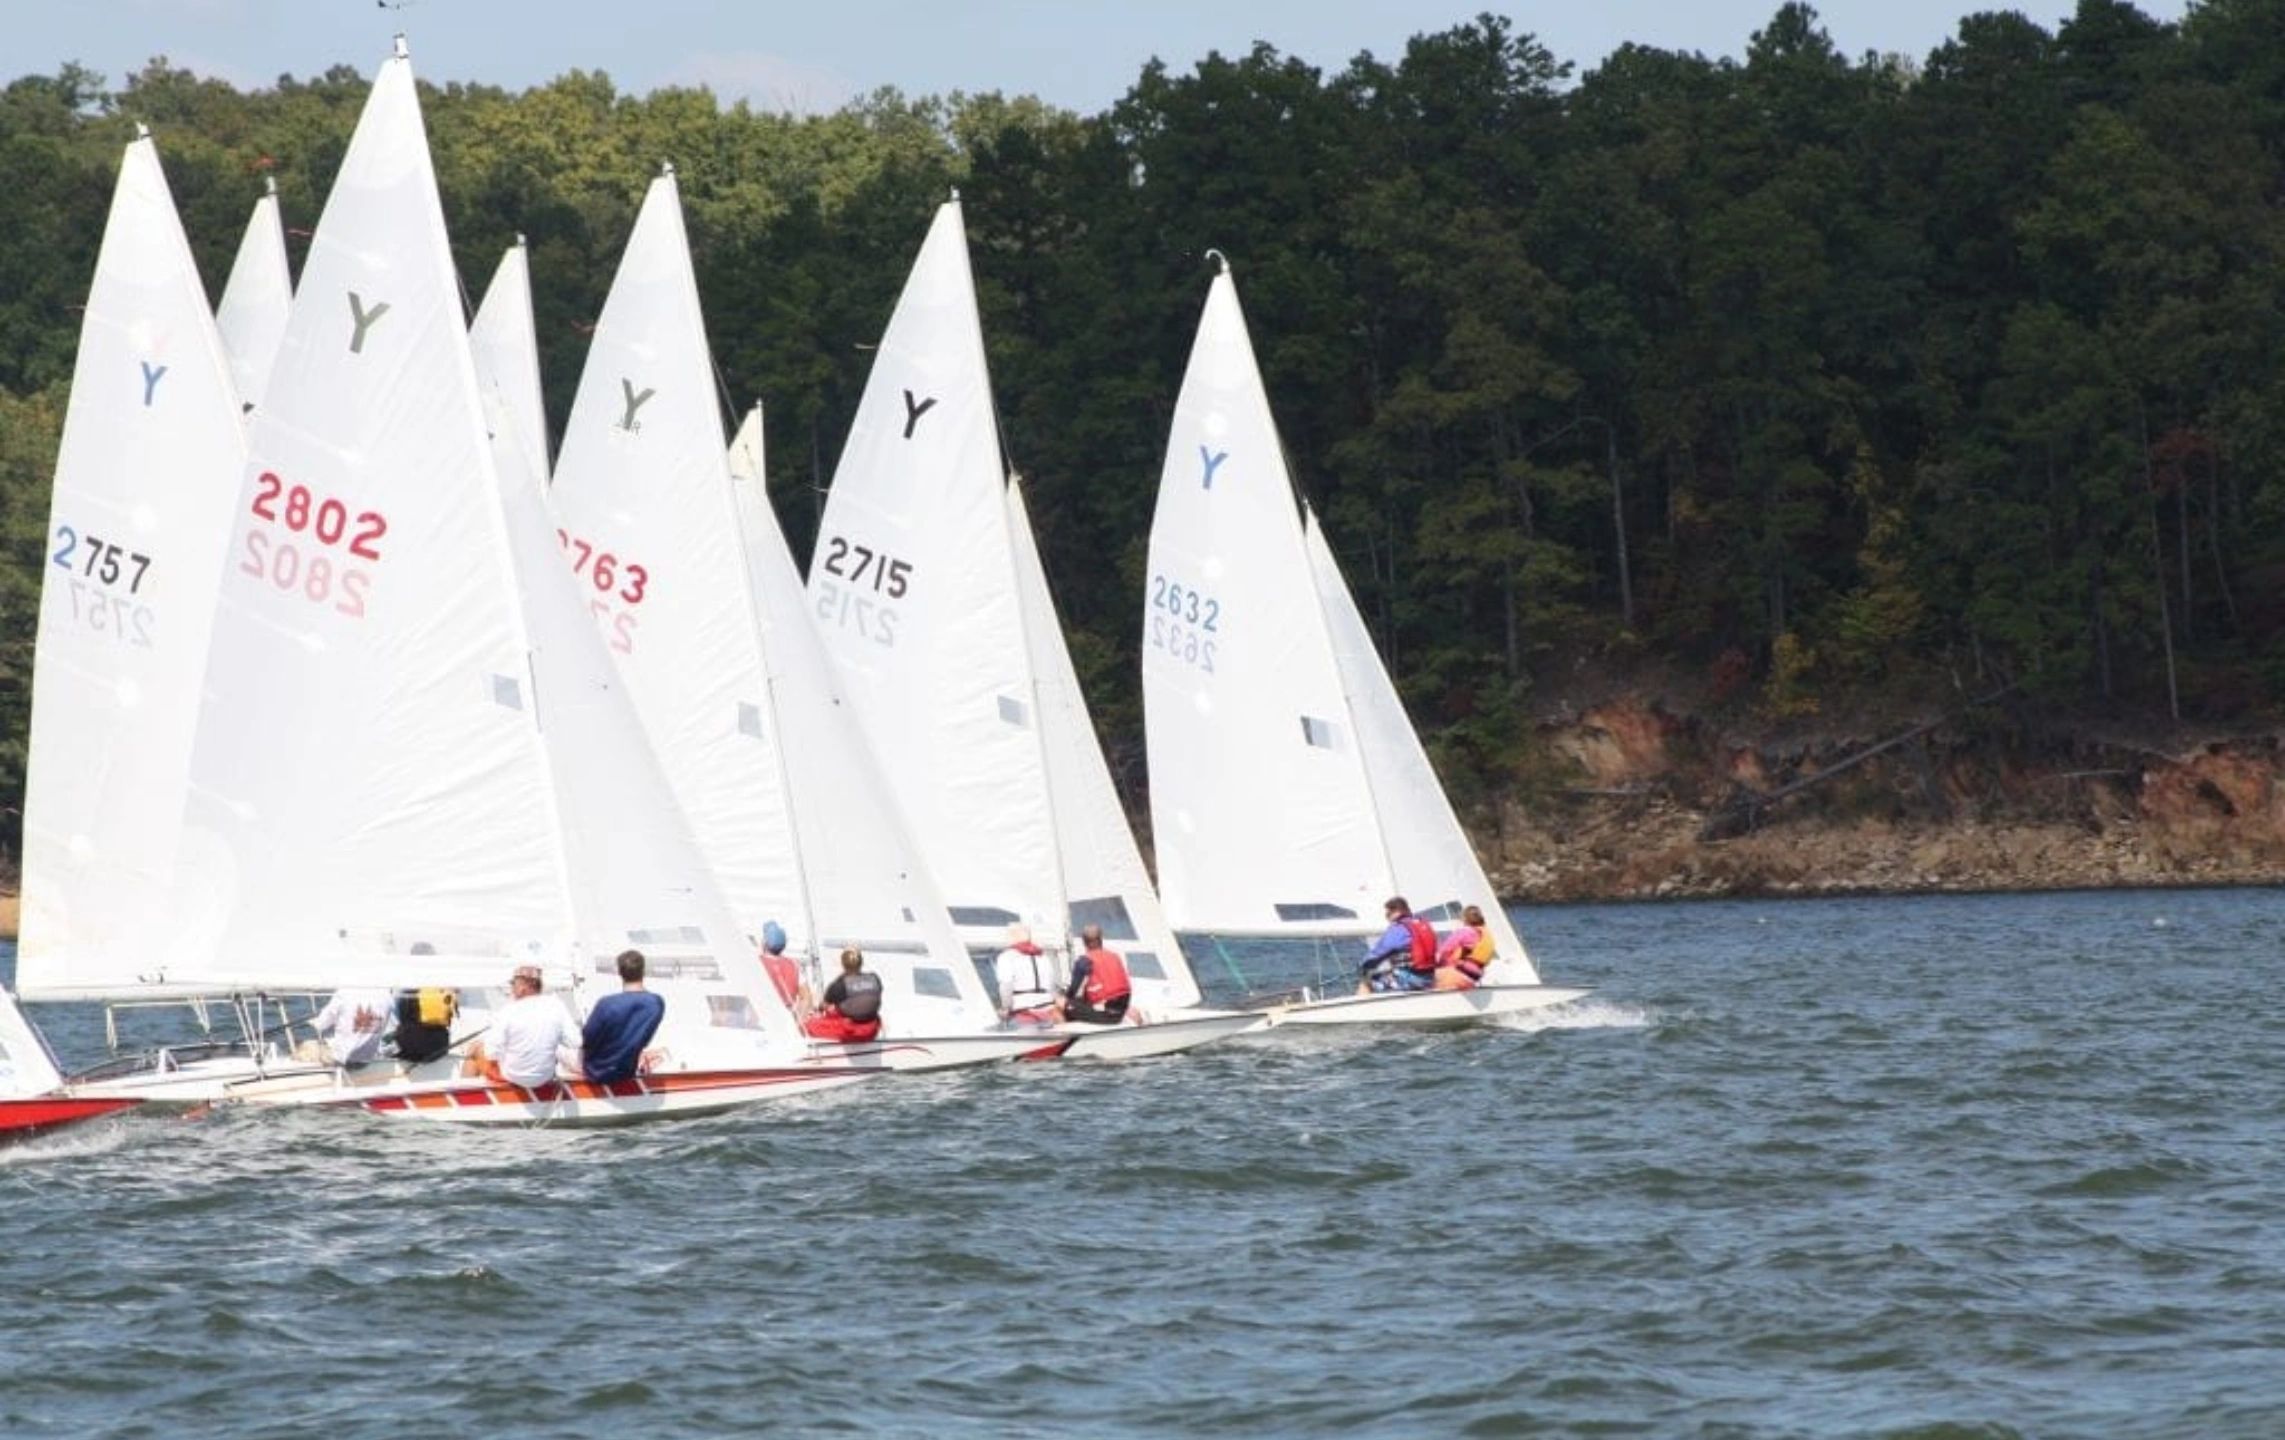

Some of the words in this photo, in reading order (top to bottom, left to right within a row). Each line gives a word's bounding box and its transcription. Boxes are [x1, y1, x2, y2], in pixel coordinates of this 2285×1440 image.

[347, 291, 391, 354] Y
[141, 361, 167, 406] Y
[622, 377, 656, 431] Y
[903, 388, 938, 440] Y
[1200, 445, 1228, 490] Y
[251, 471, 388, 562] 2802
[53, 525, 151, 594] 2757
[825, 536, 914, 599] 2715
[1153, 575, 1219, 632] 2632
